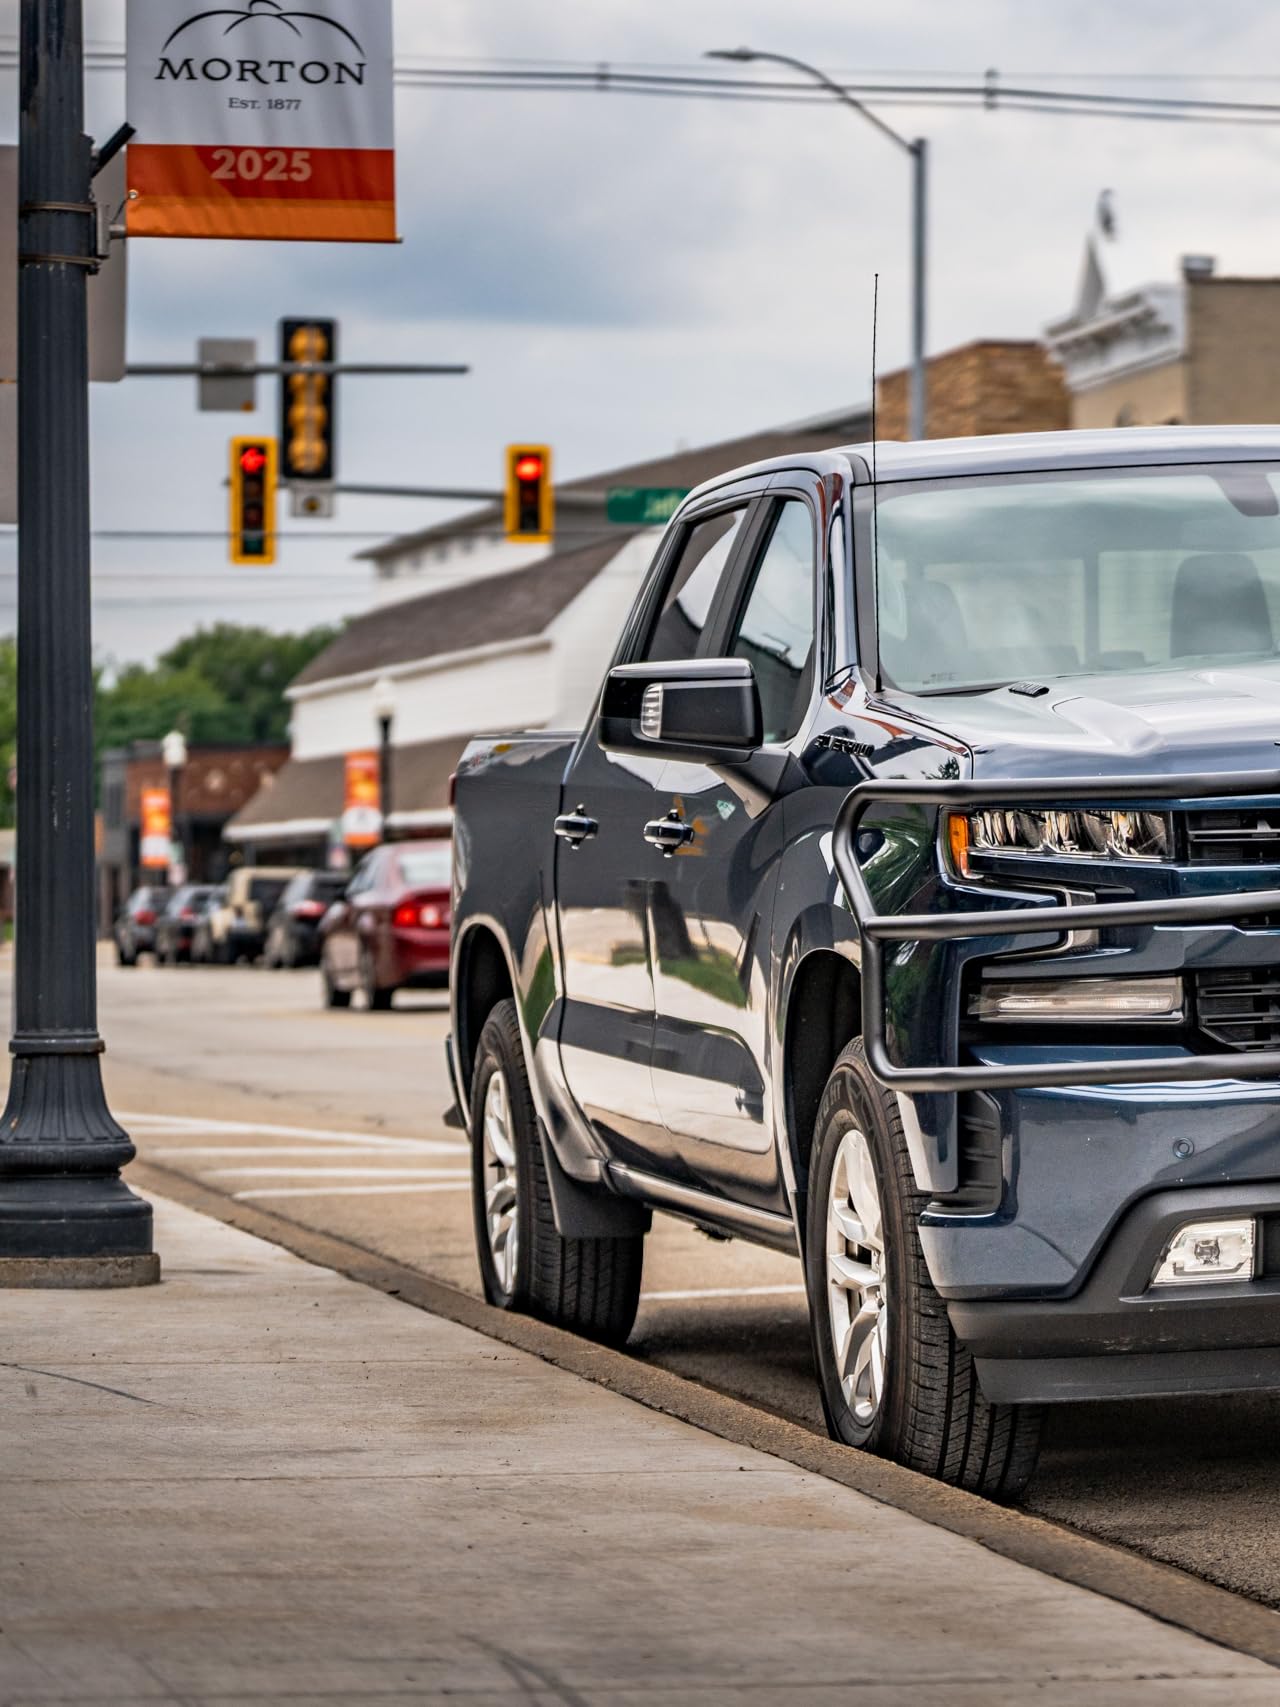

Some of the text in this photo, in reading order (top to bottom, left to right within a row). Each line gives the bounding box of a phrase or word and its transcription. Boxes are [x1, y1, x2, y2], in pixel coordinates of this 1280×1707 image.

[154, 57, 367, 85] MORTON
[267, 98, 302, 111] 1877
[210, 149, 313, 182] 2025
